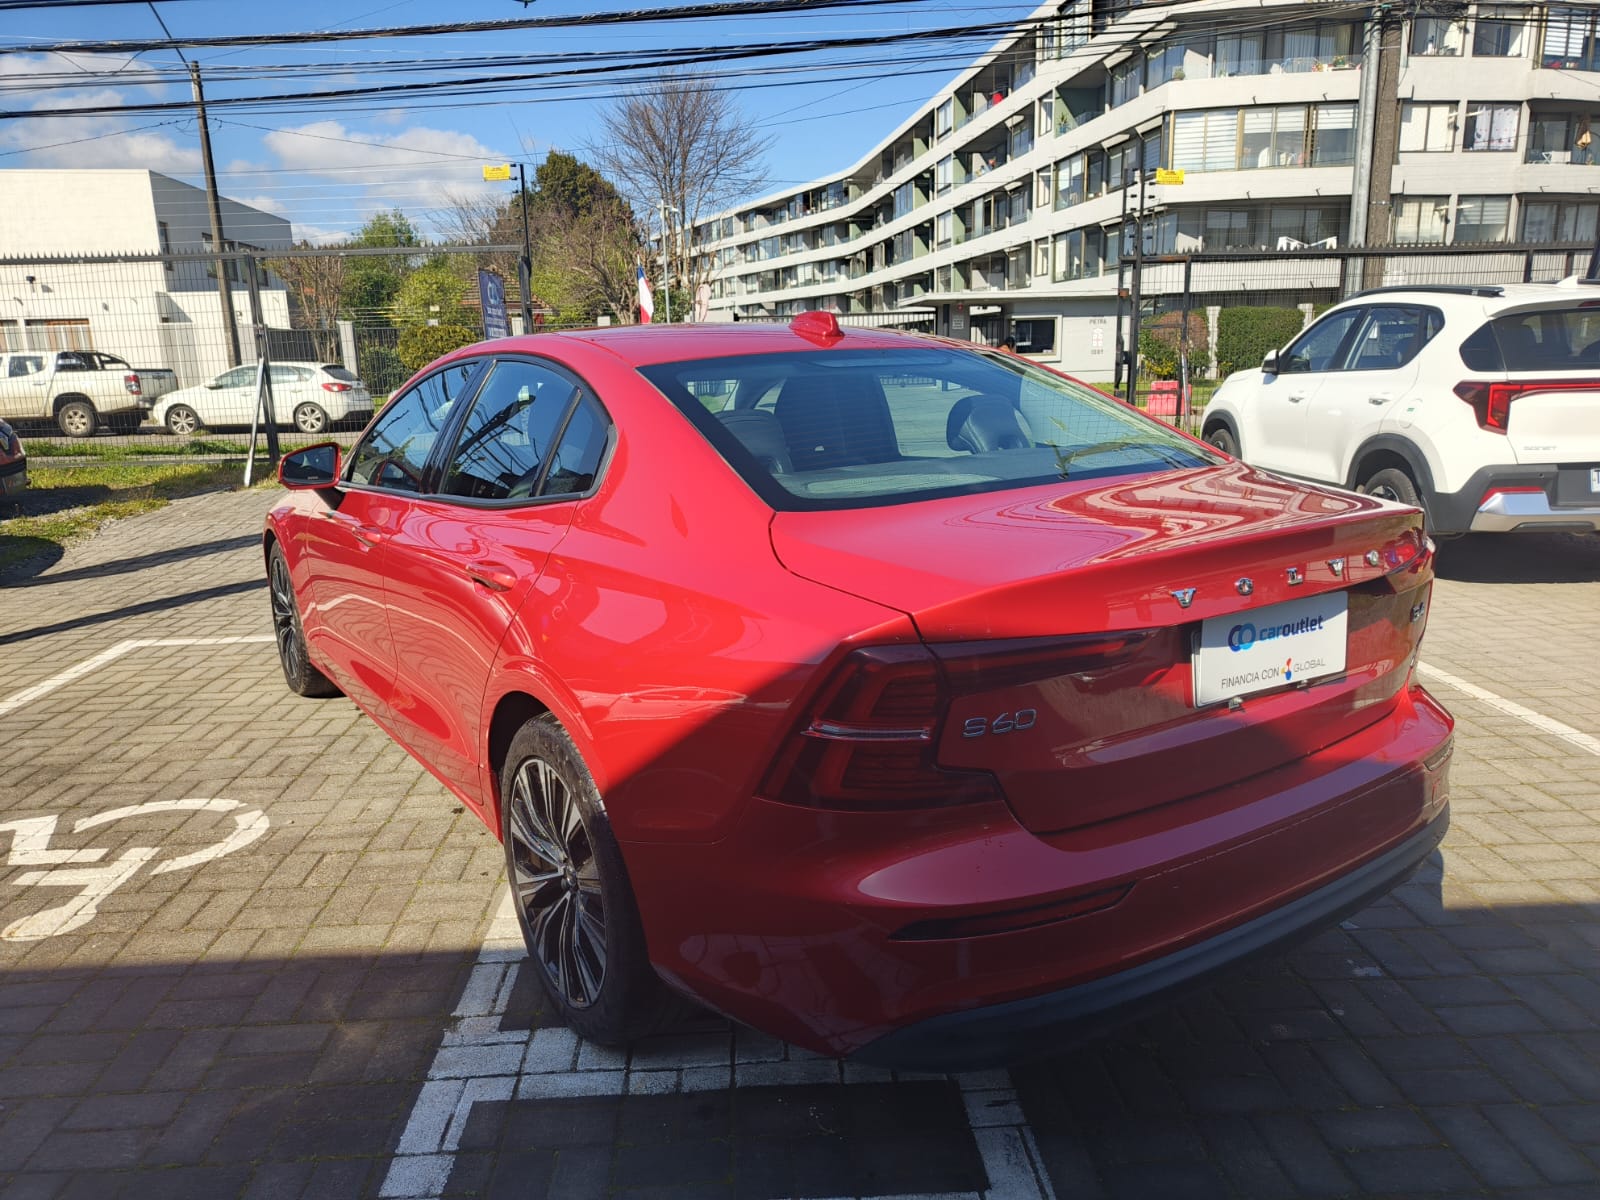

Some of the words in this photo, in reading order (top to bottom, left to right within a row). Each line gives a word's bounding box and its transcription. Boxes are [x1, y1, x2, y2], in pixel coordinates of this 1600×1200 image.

[1170, 549, 1379, 608] VOLVO
[1258, 616, 1324, 642] caroutlet
[1221, 671, 1260, 689] FINANCIA
[1261, 667, 1280, 680] CON
[1293, 658, 1326, 673] GLOBAL
[962, 708, 1037, 738] S60
